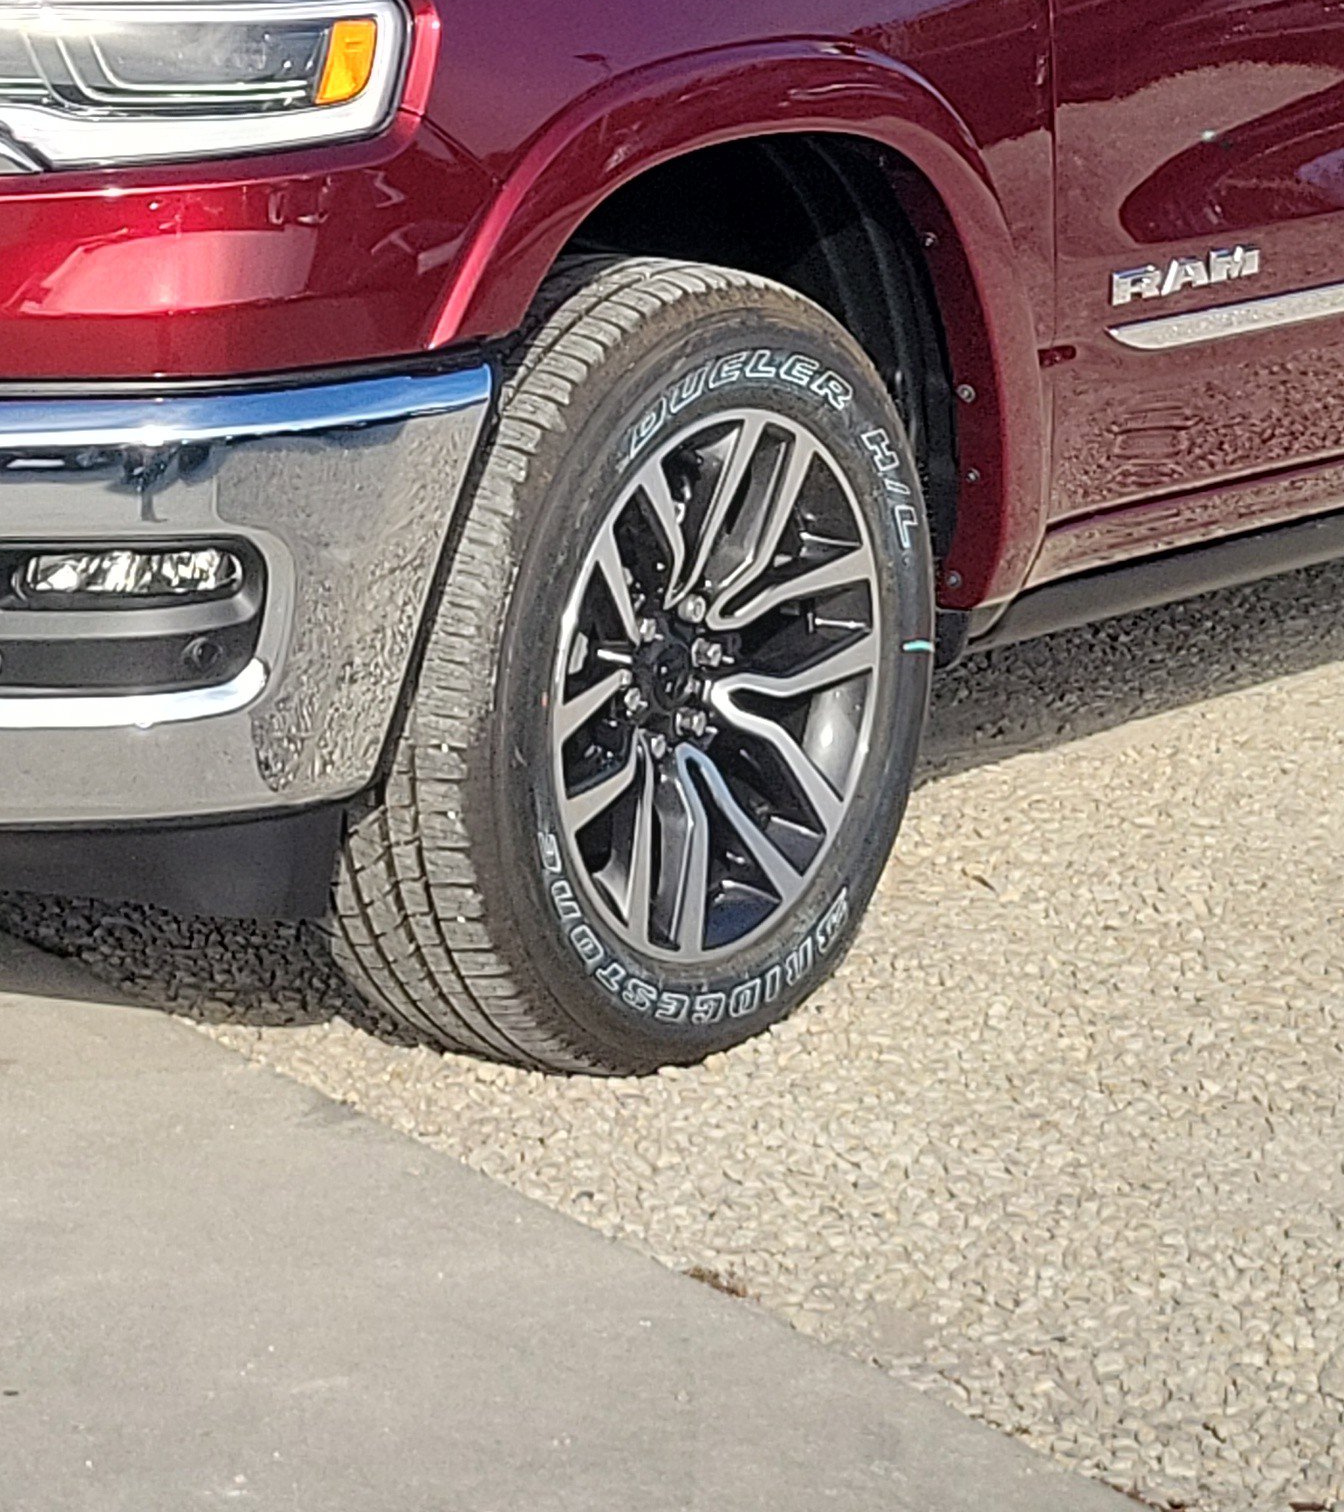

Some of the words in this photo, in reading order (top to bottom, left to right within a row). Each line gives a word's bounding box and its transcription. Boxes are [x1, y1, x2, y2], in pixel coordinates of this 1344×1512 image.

[1110, 245, 1261, 306] RAM
[624, 349, 854, 459] DUELER
[860, 428, 919, 550] H/L
[537, 831, 850, 1026] BRIDGESTONE
